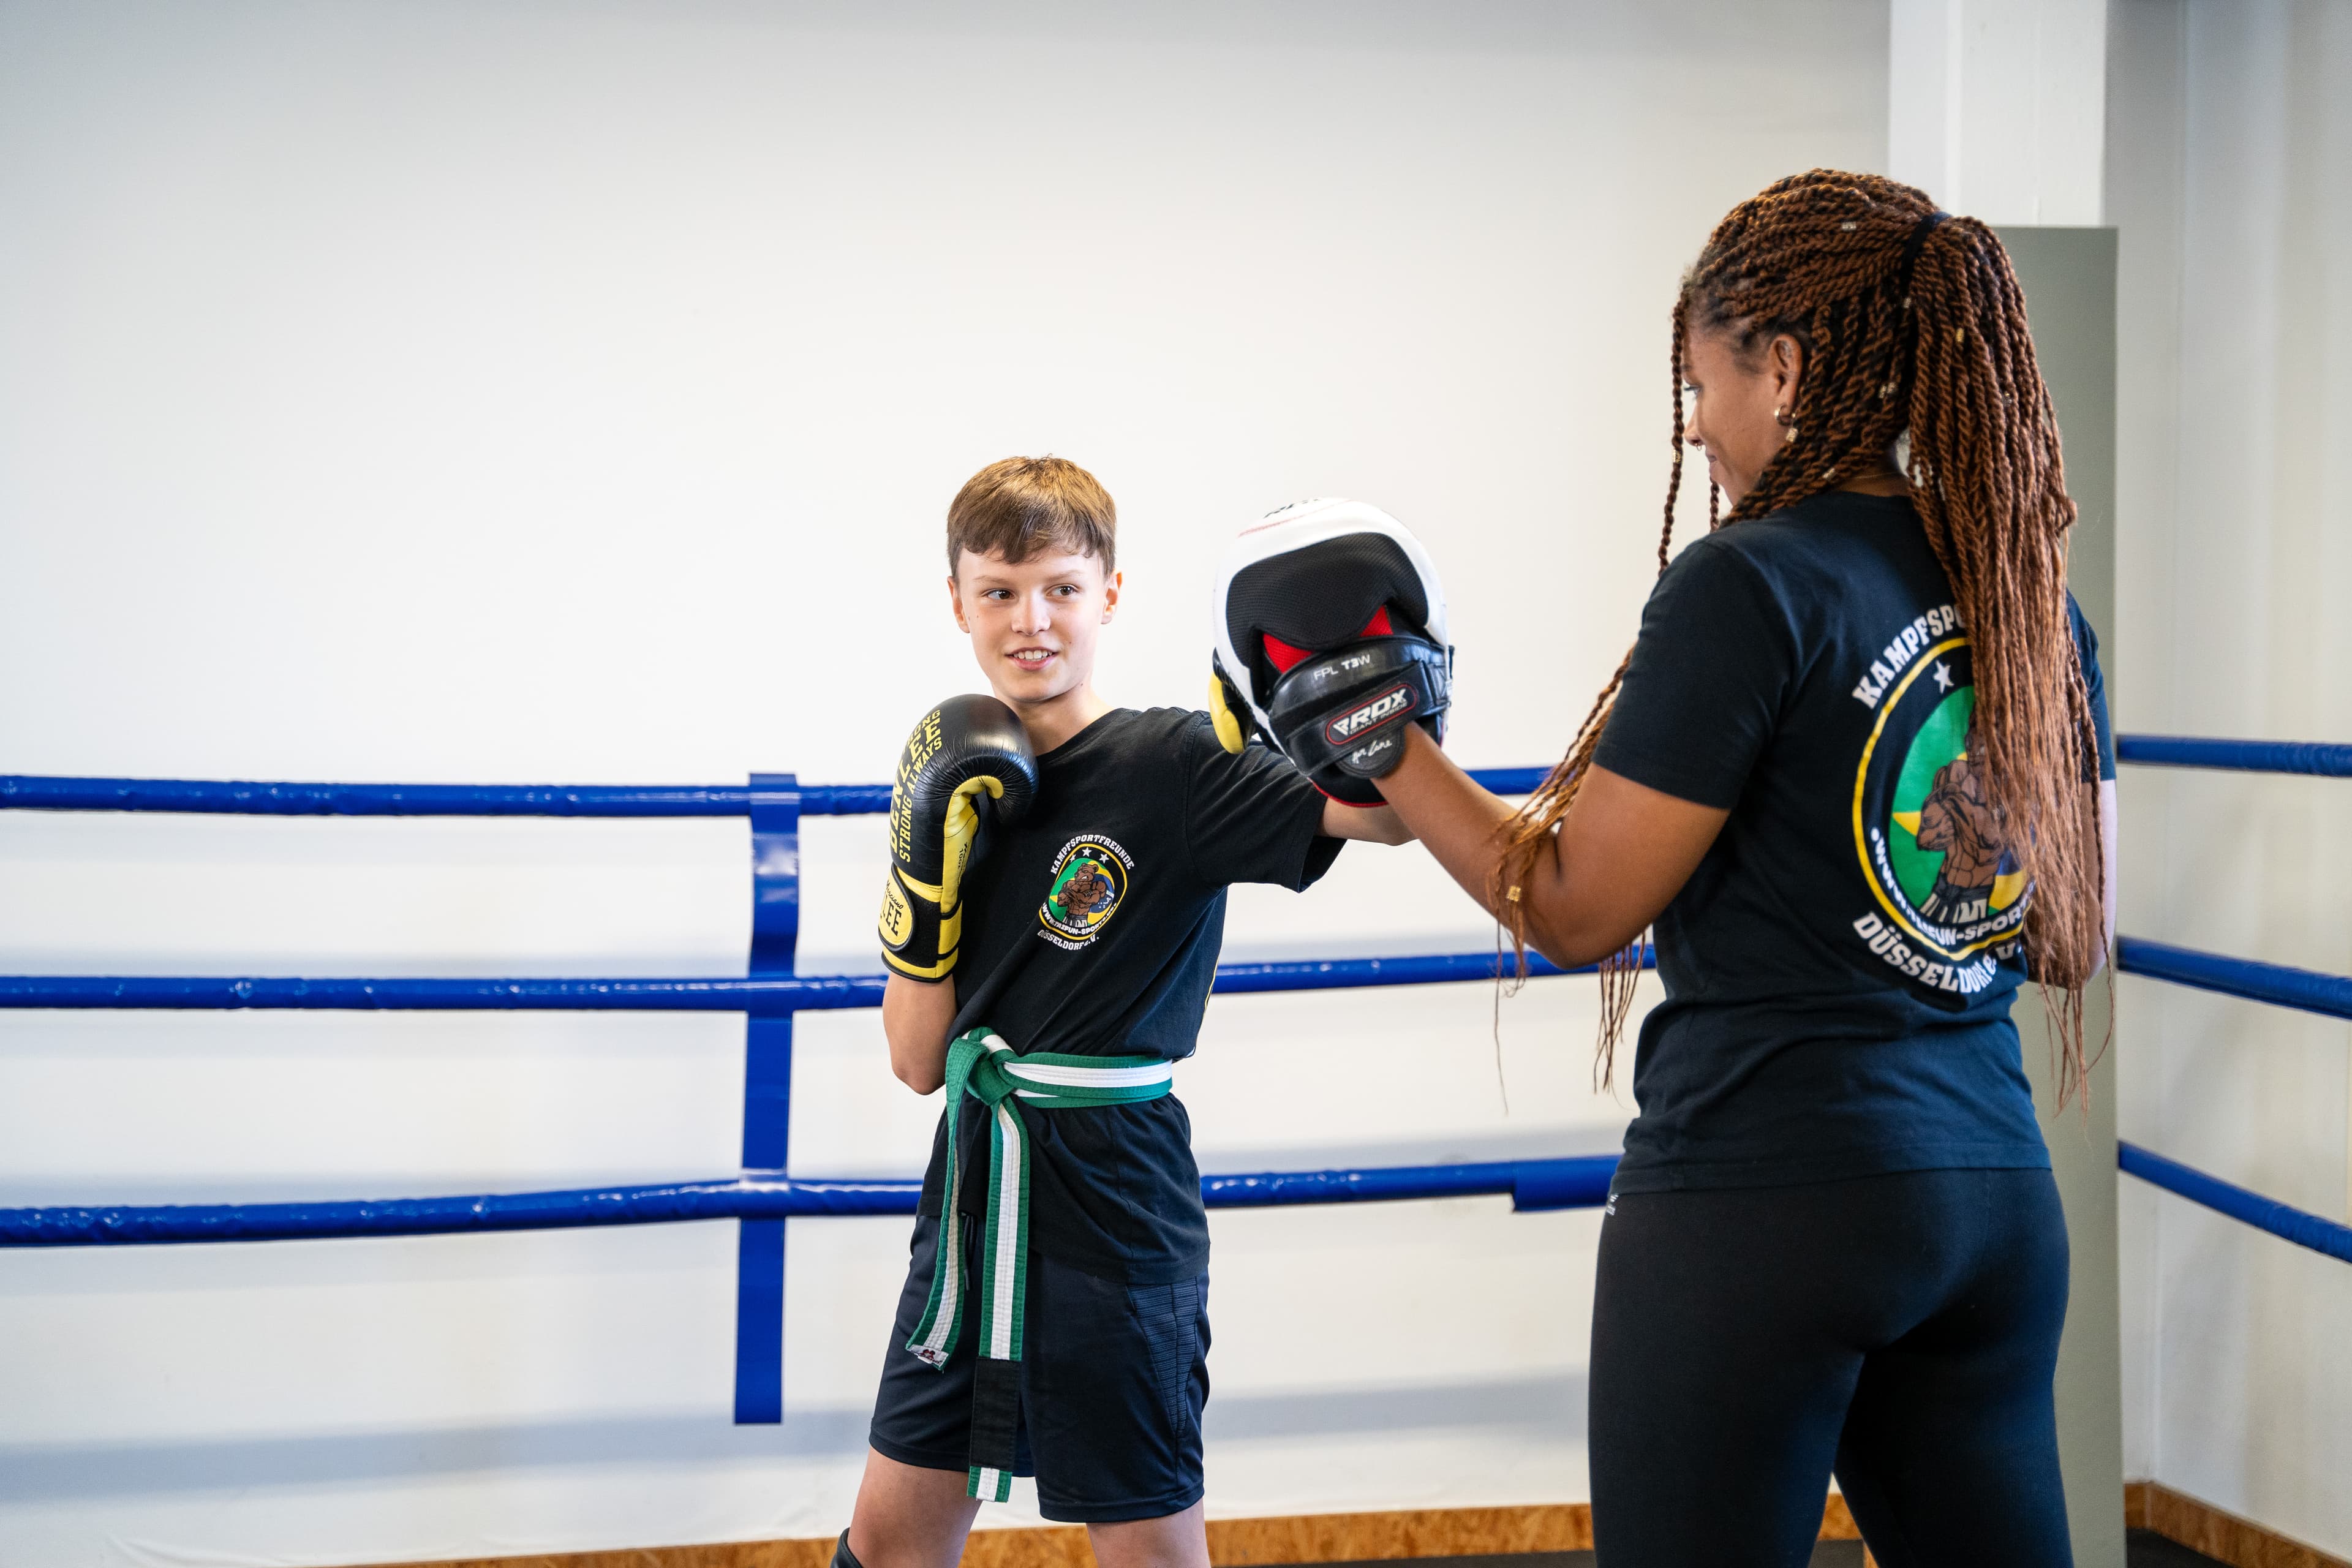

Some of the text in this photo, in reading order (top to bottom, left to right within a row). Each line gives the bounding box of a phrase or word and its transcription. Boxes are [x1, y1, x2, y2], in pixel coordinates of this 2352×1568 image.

[1313, 654, 1371, 680] FPL T3W
[1349, 688, 1407, 730] RDX
[899, 737, 943, 862] STRONG ALWAYS
[1050, 834, 1135, 875] KAMPFSPORTFREUNDE
